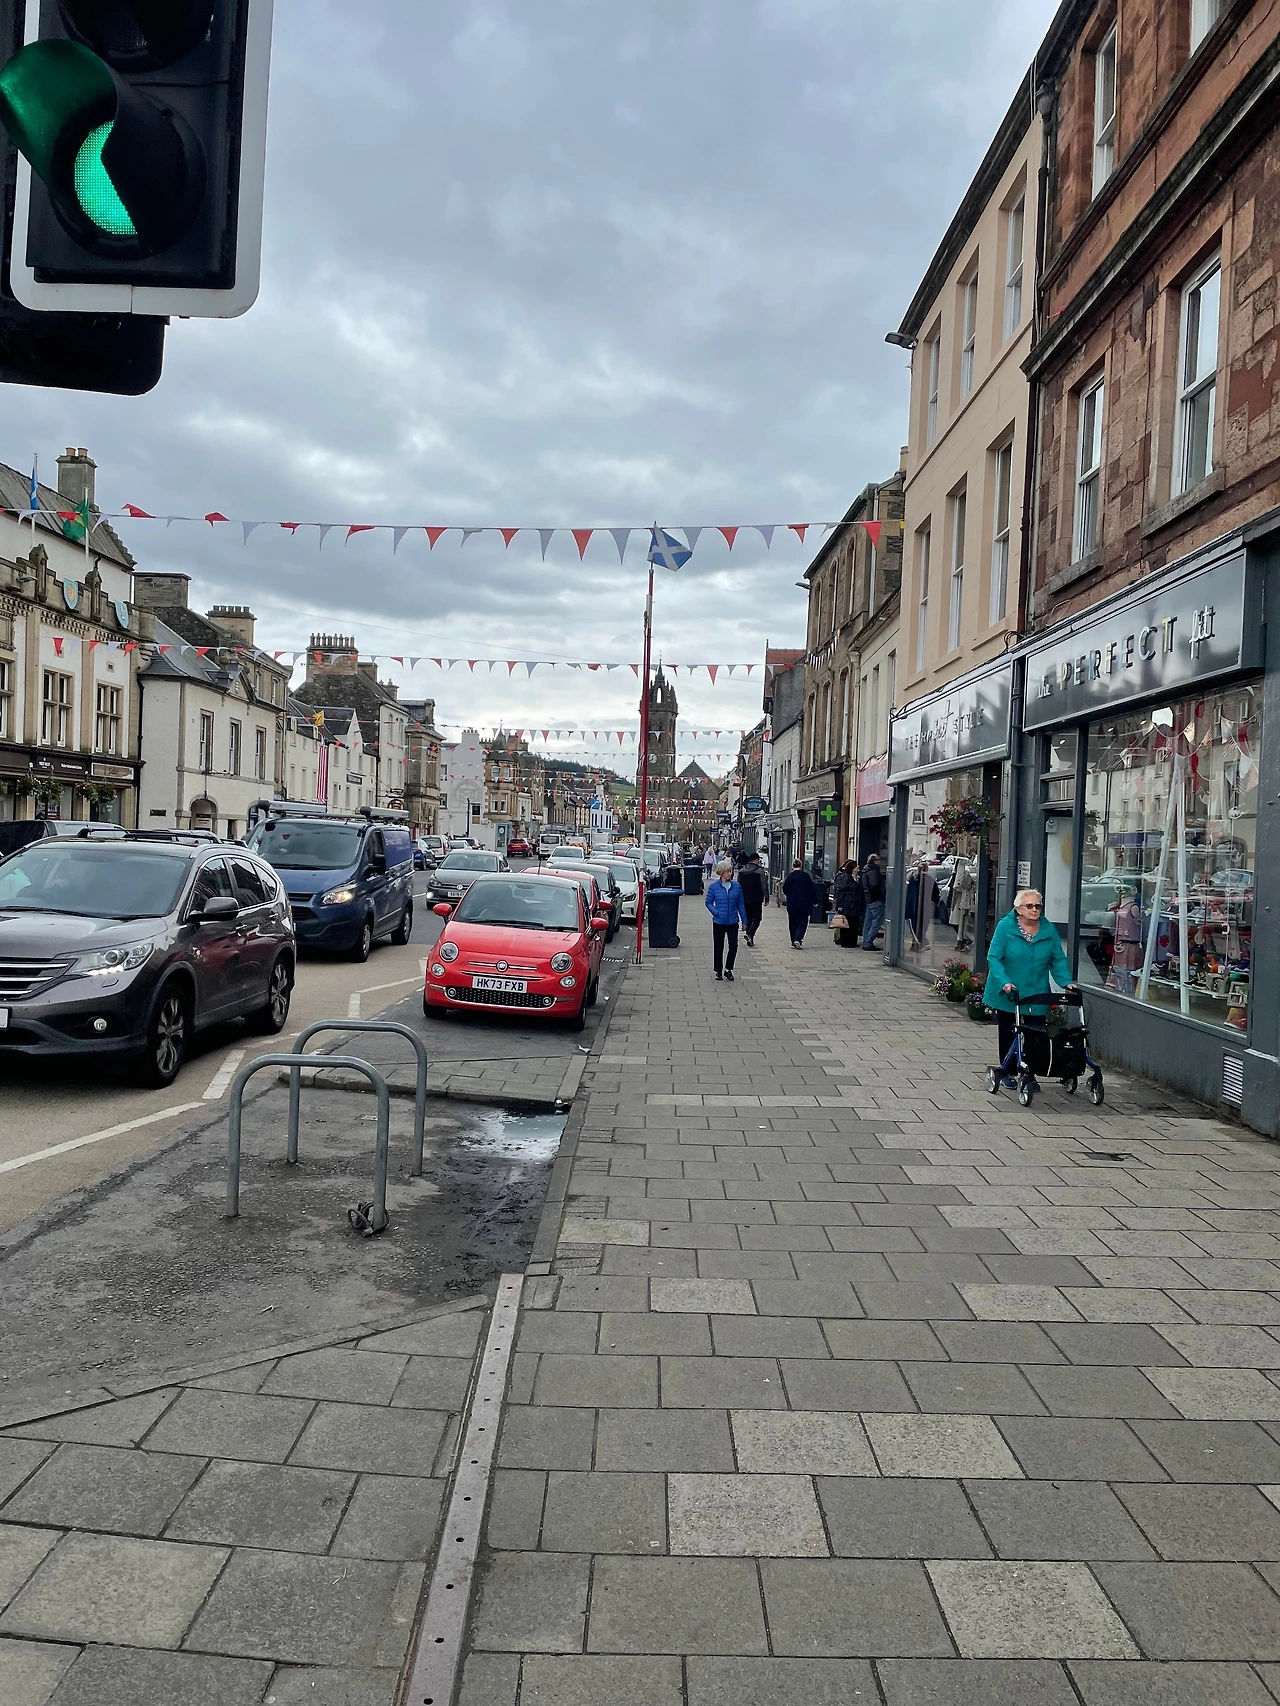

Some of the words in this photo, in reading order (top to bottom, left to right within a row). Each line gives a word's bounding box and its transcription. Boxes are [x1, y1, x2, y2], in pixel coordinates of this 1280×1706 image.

[1037, 674, 1051, 699] the
[1059, 616, 1177, 691] PERFECT
[1188, 605, 1216, 659] fit
[953, 708, 984, 735] STYLE
[477, 978, 502, 989] HK73
[504, 981, 524, 991] FXB
